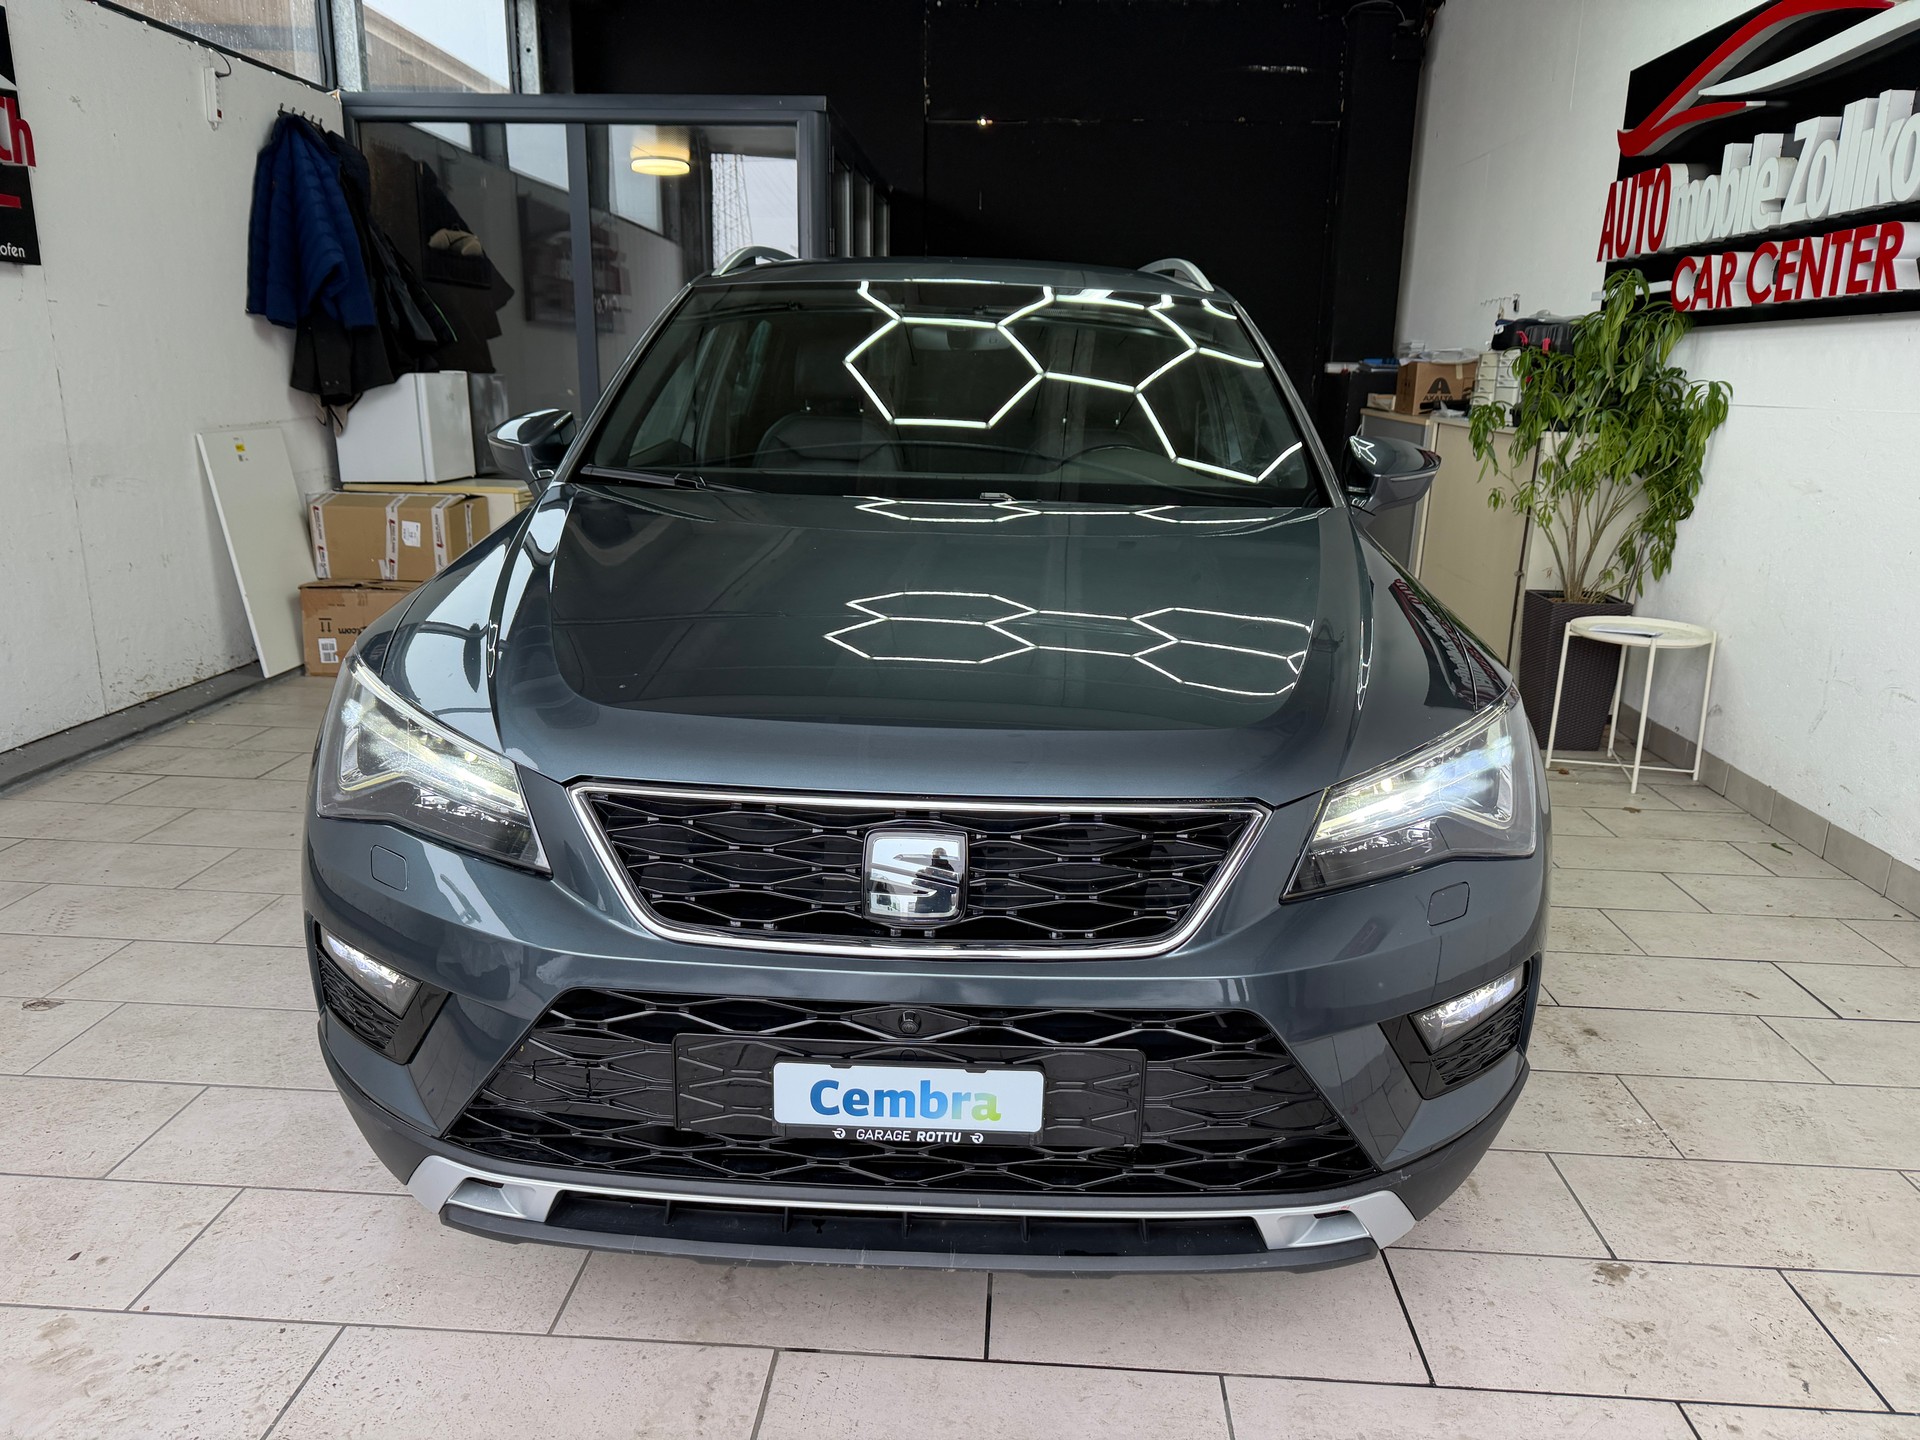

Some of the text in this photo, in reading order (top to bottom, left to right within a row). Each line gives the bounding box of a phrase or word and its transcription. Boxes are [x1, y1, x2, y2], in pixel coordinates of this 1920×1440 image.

[1670, 221, 1905, 312] CAR CENTER
[810, 1079, 1002, 1121] Cembra
[856, 1129, 911, 1142] GARAGE
[916, 1131, 962, 1143] ROTTU
